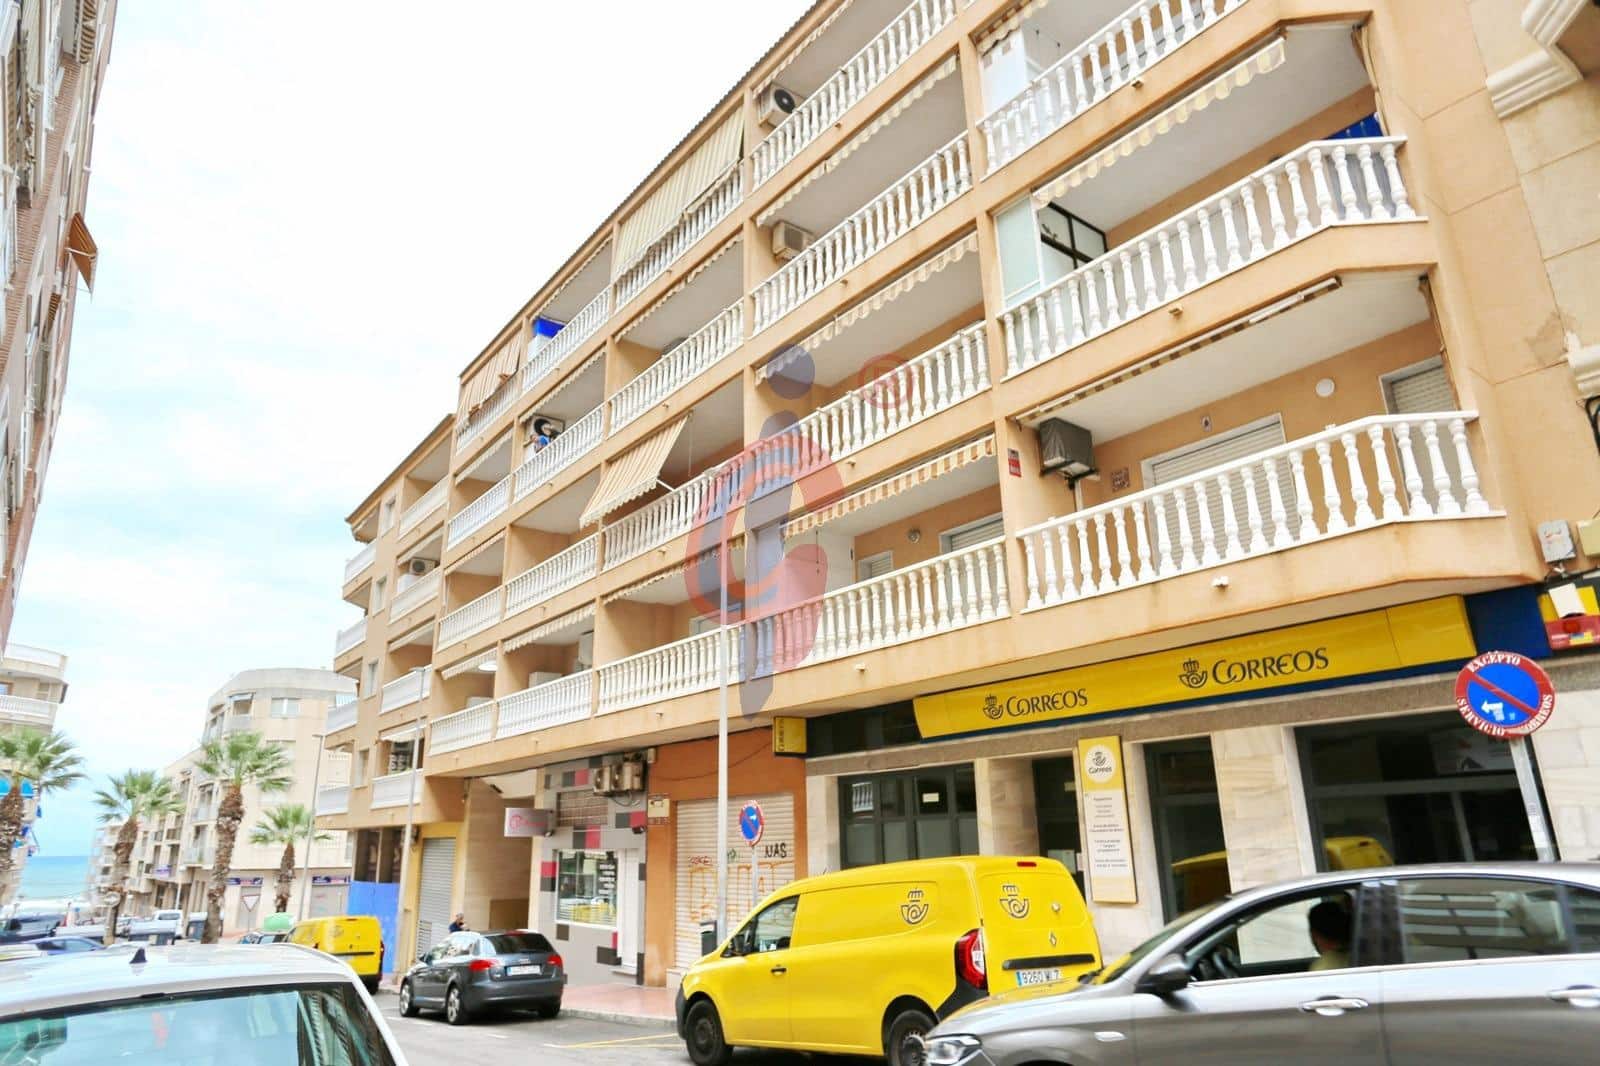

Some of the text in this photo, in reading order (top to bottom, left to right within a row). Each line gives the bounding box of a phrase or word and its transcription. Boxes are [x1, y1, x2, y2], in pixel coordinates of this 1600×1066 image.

[1213, 648, 1329, 685] CORREOS
[1466, 654, 1521, 673] EXCEPTO
[1006, 688, 1089, 718] CORREOS
[1456, 698, 1505, 737] SERVICIO
[1524, 694, 1553, 731] ORREOS
